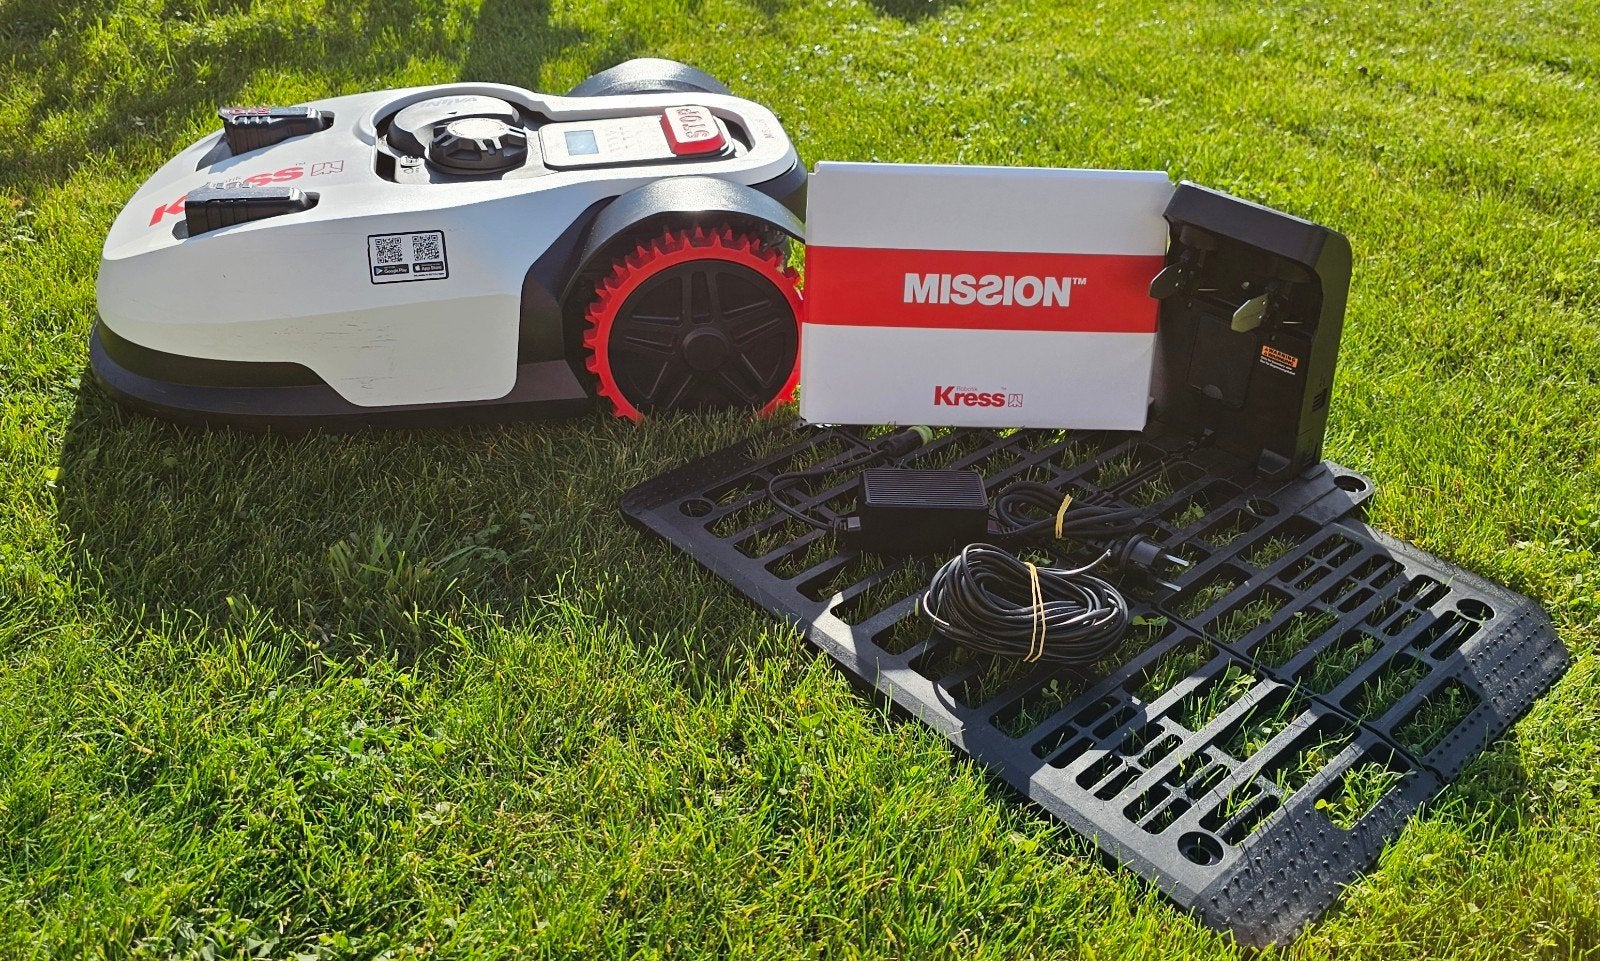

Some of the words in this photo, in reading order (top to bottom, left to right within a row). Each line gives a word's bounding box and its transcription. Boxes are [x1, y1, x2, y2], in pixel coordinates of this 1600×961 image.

[676, 108, 710, 139] STOP
[1268, 348, 1296, 363] WARNING
[933, 385, 1006, 408] Kress
